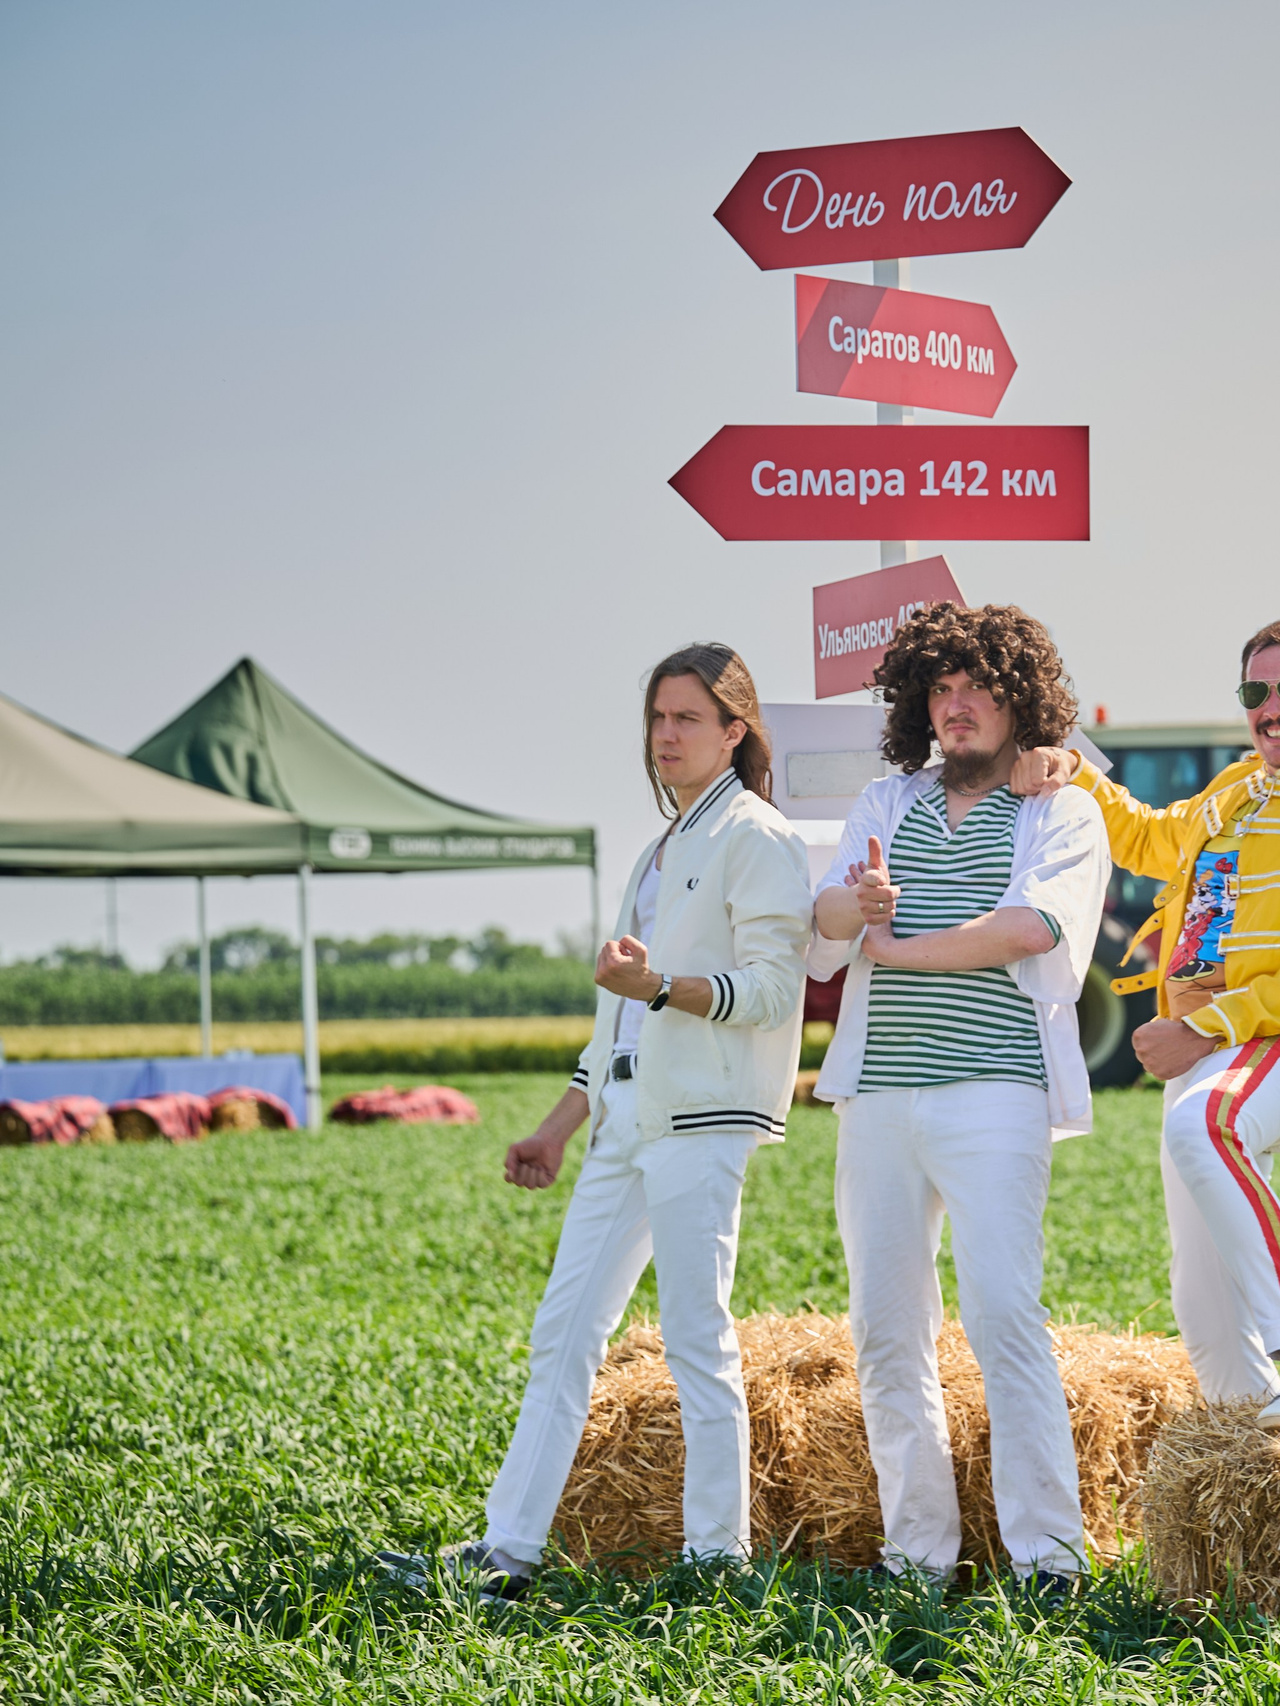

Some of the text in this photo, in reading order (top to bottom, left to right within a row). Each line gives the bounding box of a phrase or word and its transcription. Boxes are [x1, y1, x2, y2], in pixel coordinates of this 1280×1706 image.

[763, 168, 1017, 233] День поля
[828, 315, 995, 376] Саратов 400 км
[751, 460, 1057, 505] Самара 142 км
[818, 616, 894, 660] Ульяновск
